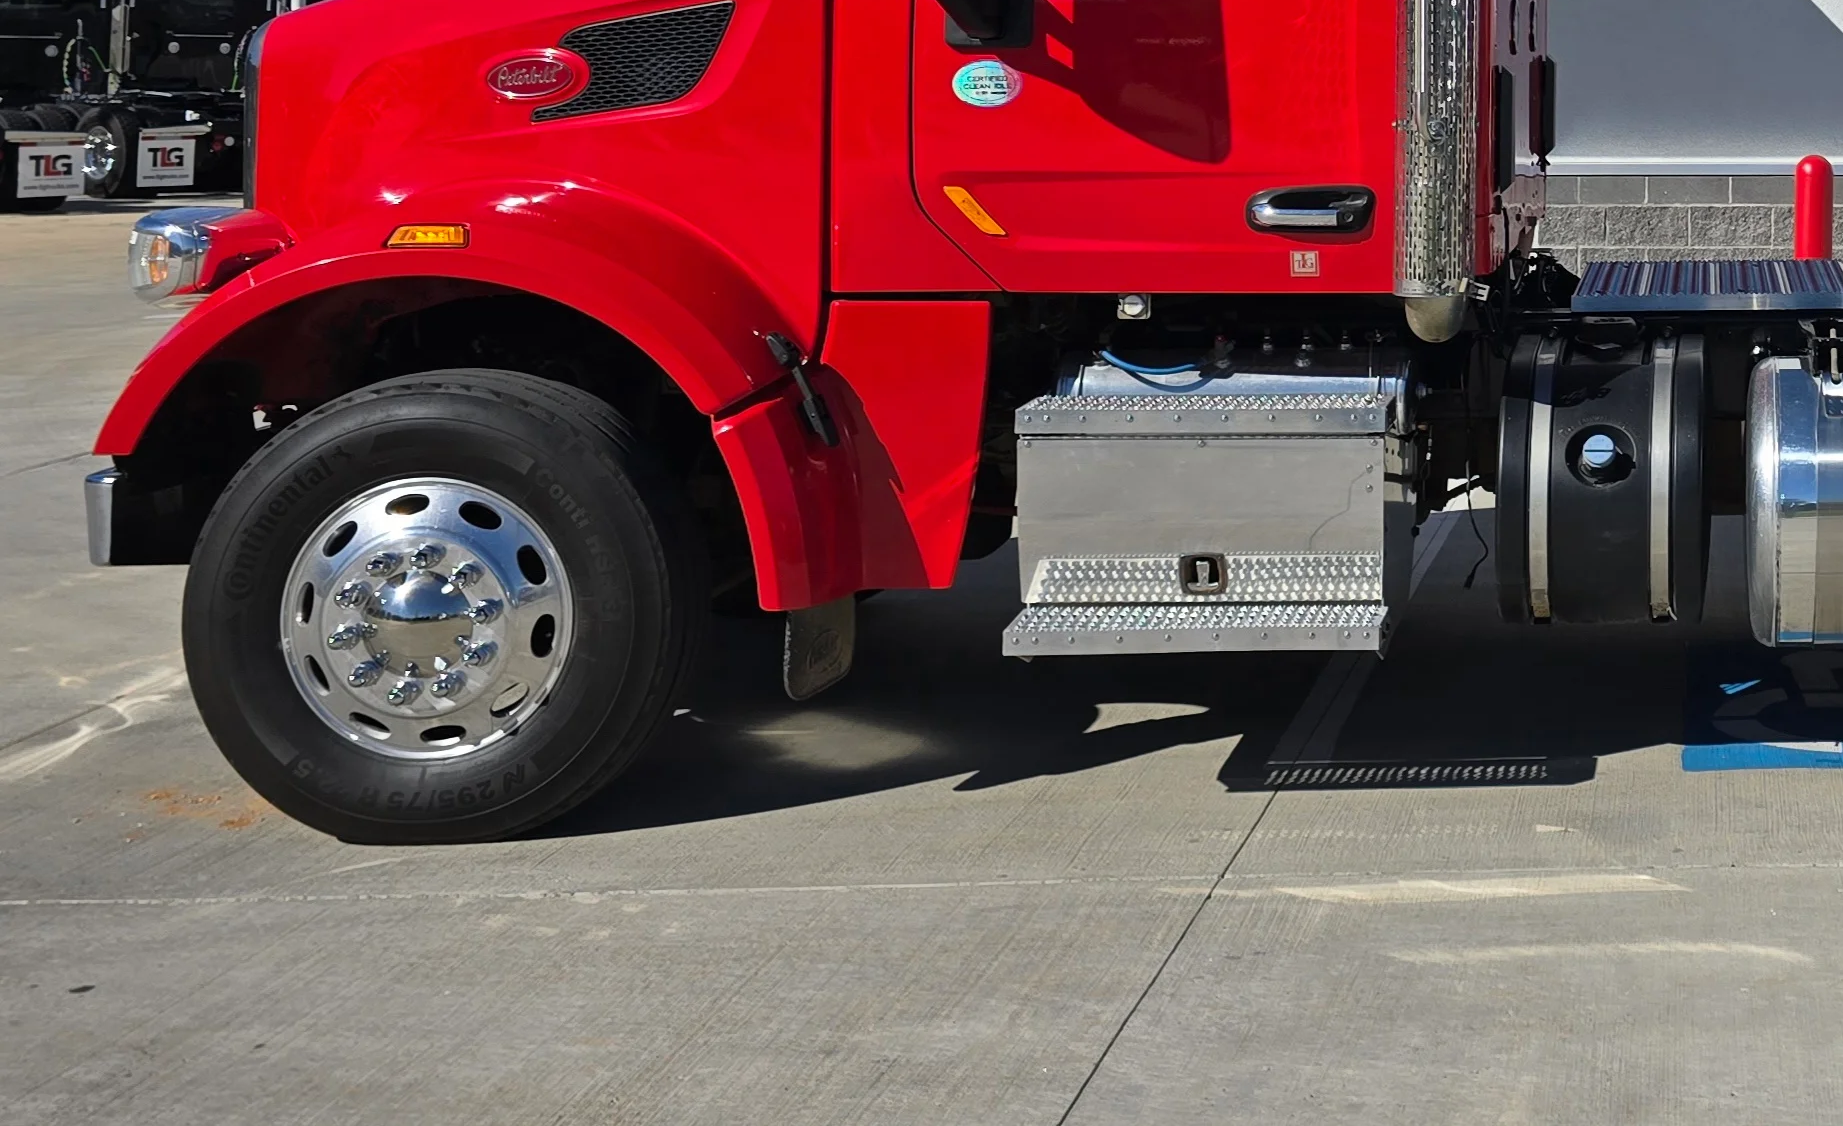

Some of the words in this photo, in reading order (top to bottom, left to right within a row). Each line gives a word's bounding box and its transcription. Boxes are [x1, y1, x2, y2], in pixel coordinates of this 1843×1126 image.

[498, 66, 563, 88] Peterbilt
[29, 155, 72, 177] TLG
[148, 147, 184, 168] TLG
[223, 455, 334, 601] Continental
